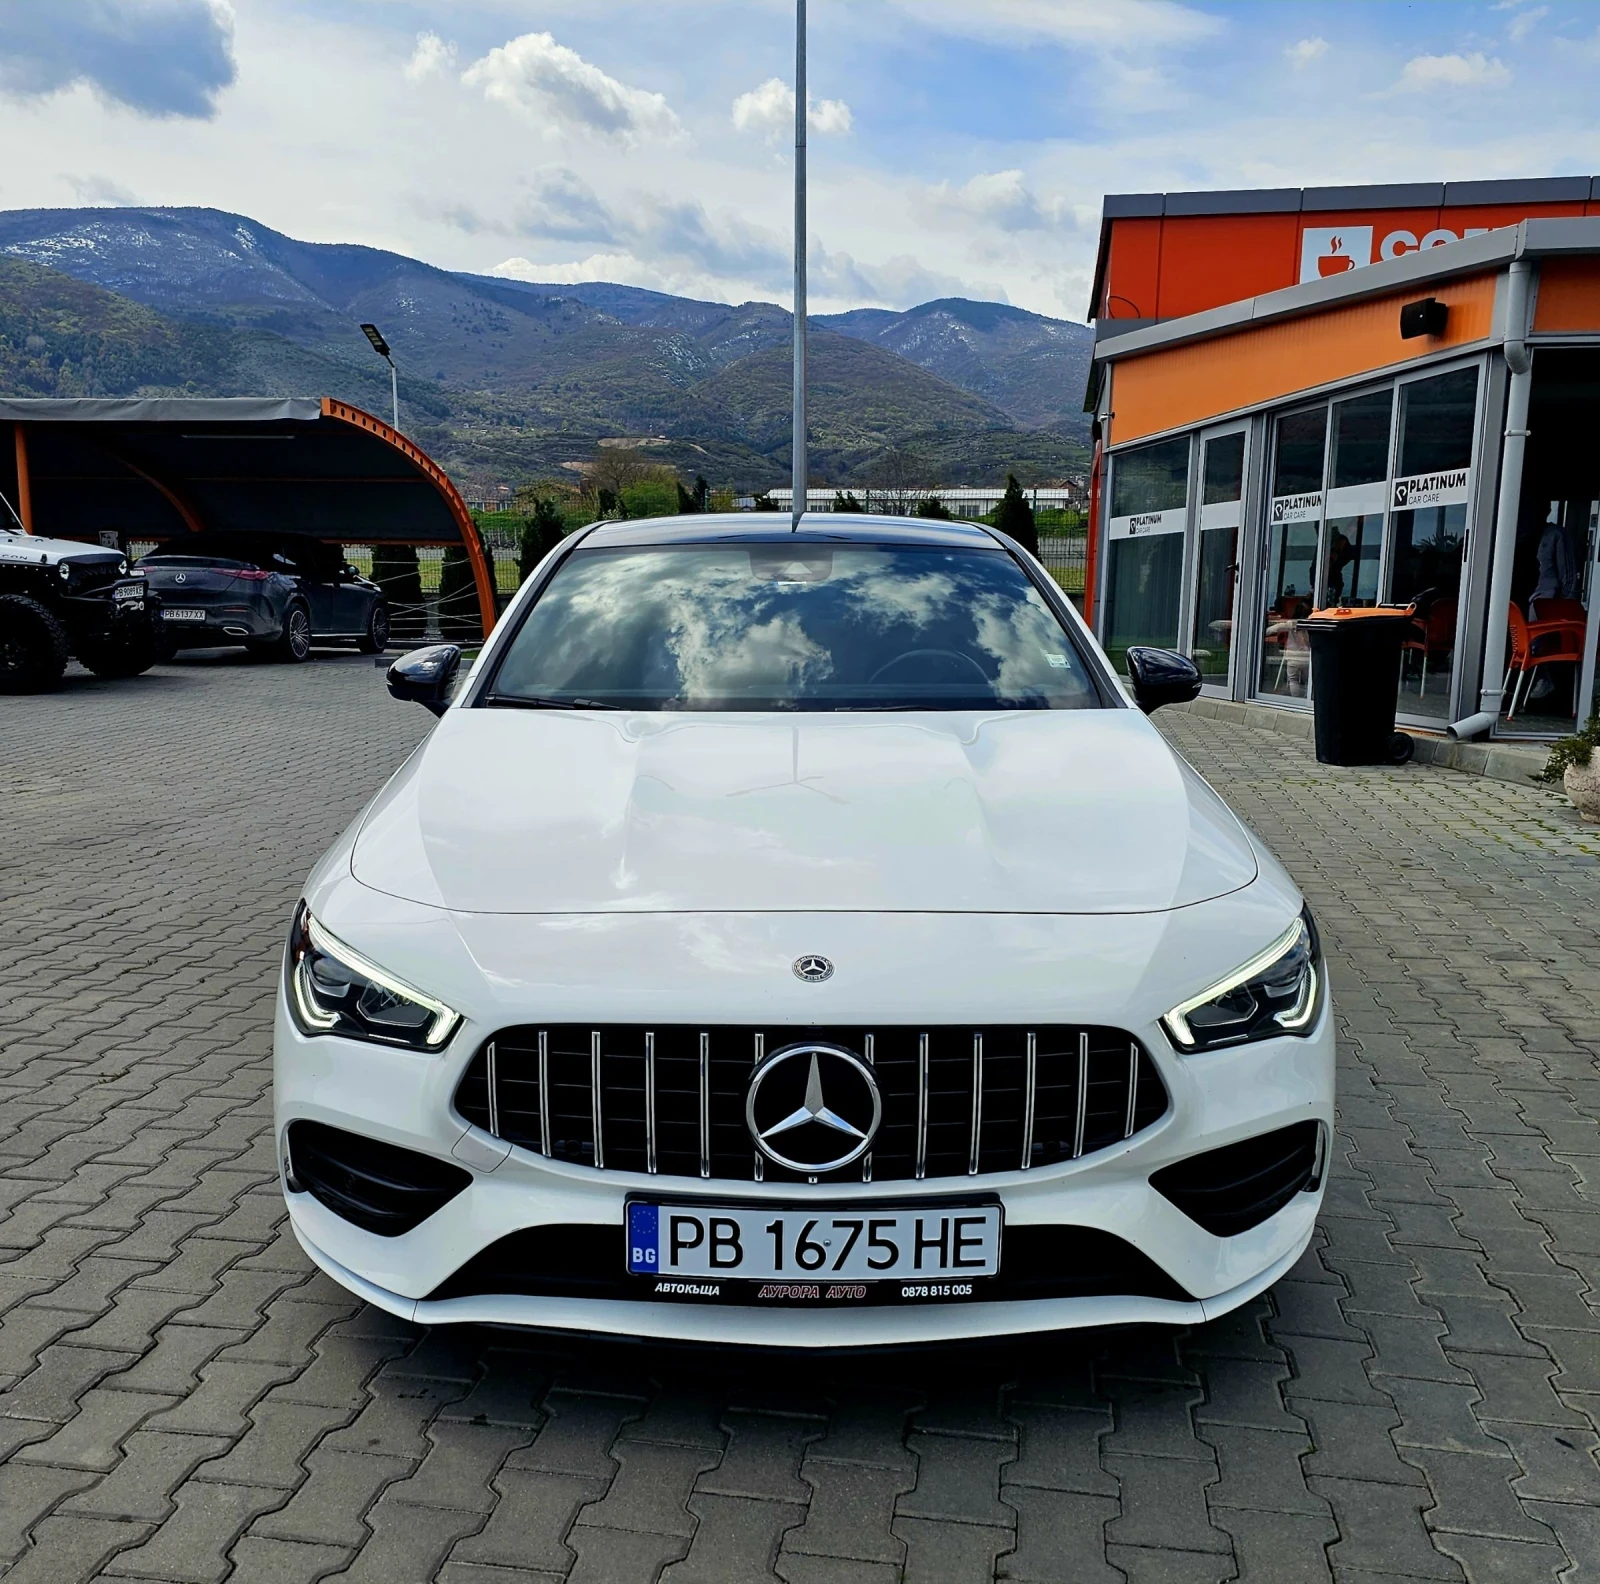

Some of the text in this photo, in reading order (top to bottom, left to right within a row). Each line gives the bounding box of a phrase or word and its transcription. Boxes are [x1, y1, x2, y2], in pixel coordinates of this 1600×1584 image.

[1409, 472, 1466, 493] PLATINUM
[1408, 493, 1440, 505] CAR CARE
[1136, 513, 1162, 526] PLATINUM
[165, 610, 204, 618] PB 6137 XX
[669, 1215, 987, 1271] PB 1675 HE
[632, 1247, 656, 1264] BG
[654, 1282, 720, 1296] АВТОКЪЩА
[757, 1285, 867, 1299] АУРОРА АУТО
[901, 1284, 973, 1298] 0878 815 005
